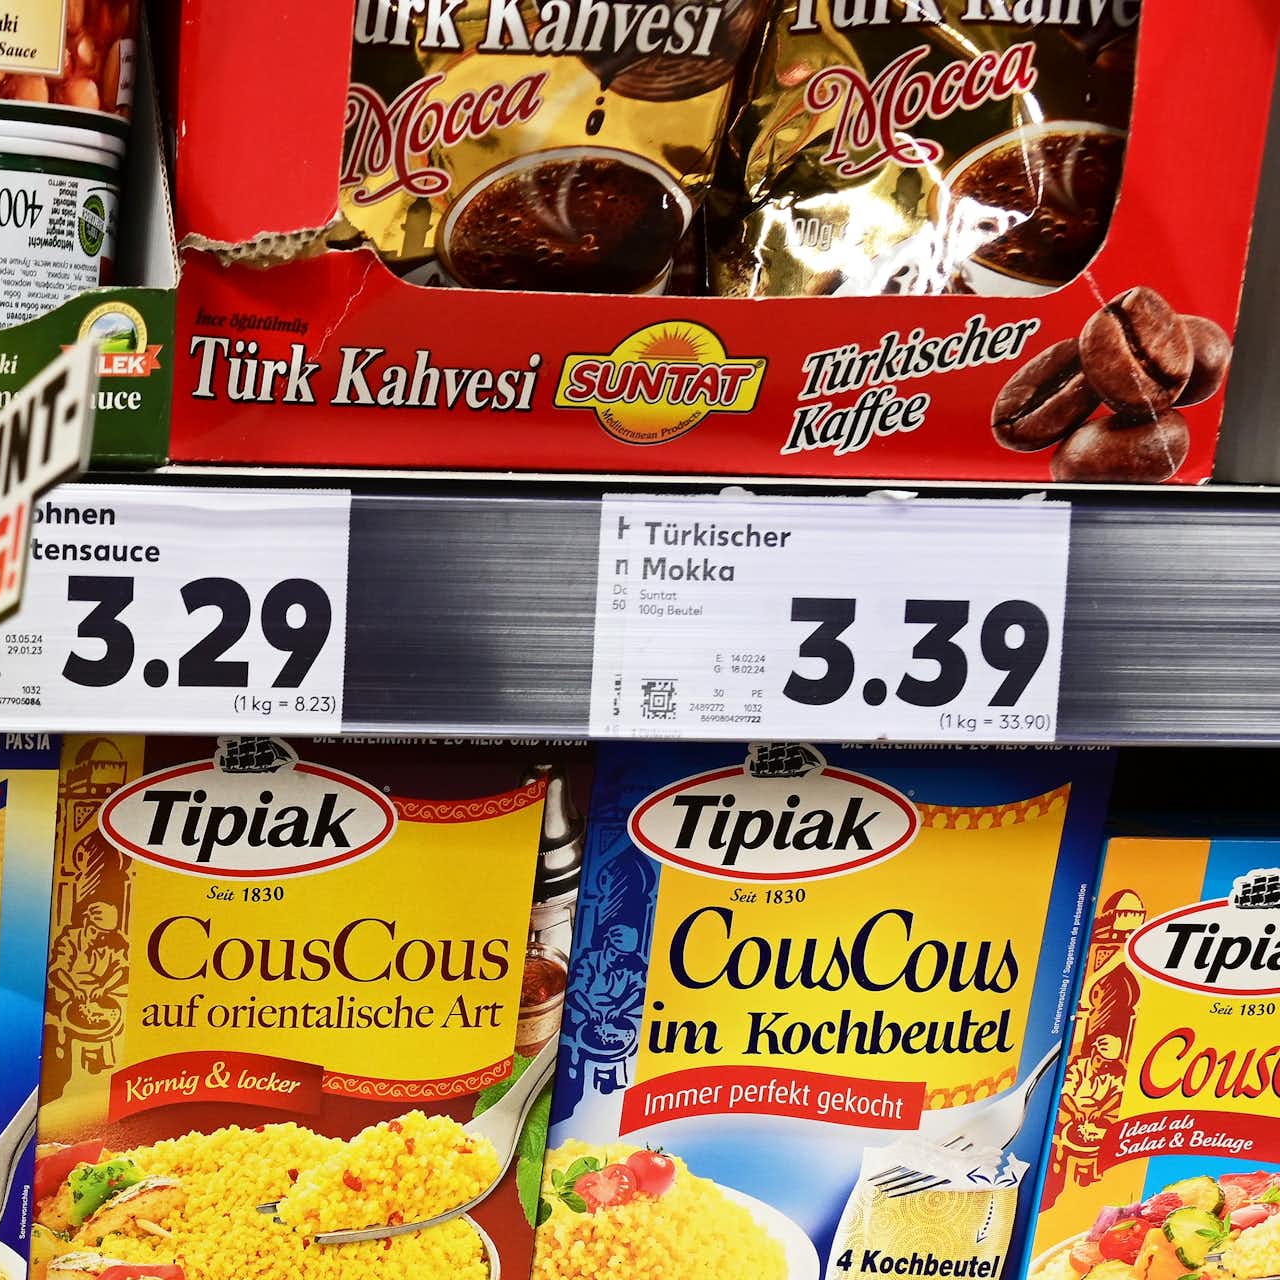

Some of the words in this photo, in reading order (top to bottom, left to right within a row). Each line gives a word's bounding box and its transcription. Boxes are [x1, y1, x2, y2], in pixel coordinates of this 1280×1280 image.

[341, 72, 550, 206] Mocca
[190, 335, 318, 402] Türk
[332, 347, 541, 410] Kahvesi
[802, 314, 1040, 400] Türkischer
[568, 361, 756, 406] SUNTAT
[600, 407, 659, 441] Mediterranean
[661, 409, 702, 437] Products
[782, 392, 929, 454] Kaffee
[642, 556, 734, 582] Mokka
[639, 605, 664, 617] 100g
[667, 605, 702, 616] Beutel
[640, 590, 677, 600] Suntat
[62, 576, 331, 688] 3.29
[783, 598, 1049, 707] 3.39
[141, 993, 205, 1028] auf
[210, 994, 434, 1030] orientalische
[442, 995, 503, 1029] Art
[648, 1002, 723, 1055] im
[748, 1009, 1014, 1056] Kochbeutel
[643, 1087, 721, 1115] Immer
[729, 1081, 810, 1107] perfekt
[817, 1090, 903, 1119] gekocht
[836, 1250, 852, 1271] 4
[861, 1250, 1000, 1277] Kochbeutel
